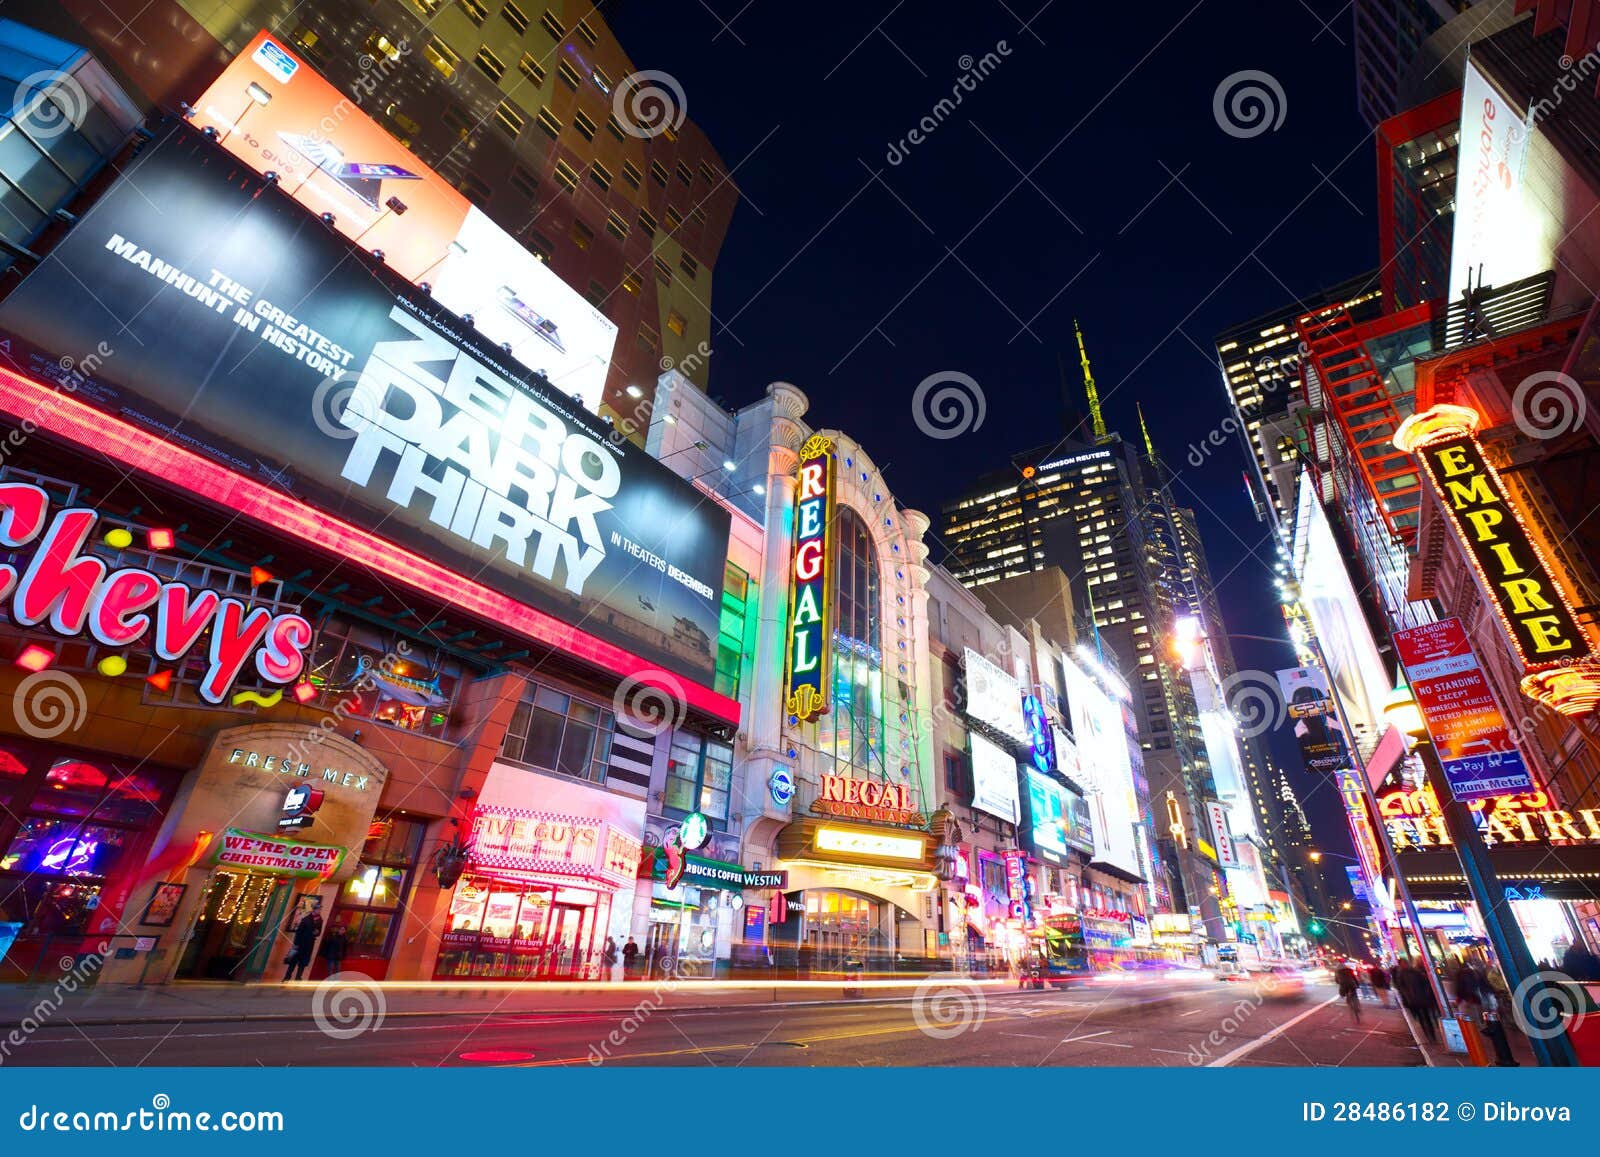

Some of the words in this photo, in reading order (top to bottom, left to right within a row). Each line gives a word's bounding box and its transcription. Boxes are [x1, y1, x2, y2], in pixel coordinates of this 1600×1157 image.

[261, 149, 294, 174] give
[105, 233, 234, 315] MANHUNT
[232, 309, 261, 333] IN
[261, 325, 347, 382] HISTORY
[208, 268, 253, 305] THE
[254, 299, 355, 367] GREATEST
[397, 295, 418, 311] FROM
[417, 308, 431, 321] THE
[430, 317, 463, 344] ACADEMY
[541, 393, 566, 417] DIRECTOR
[573, 416, 586, 430] THE
[586, 426, 603, 442] HURT
[602, 437, 626, 457] LOCKER
[373, 304, 621, 499] ZERO
[346, 354, 614, 555] DARK
[1038, 457, 1075, 472] THOMSON
[1076, 451, 1111, 463] REUTERS
[339, 408, 606, 596] THIRTY
[1434, 445, 1573, 653] EMPIRE
[610, 531, 622, 546] IN
[622, 536, 667, 573] THEATERS
[667, 564, 714, 600] DECEMBER
[794, 463, 825, 674] REGAL
[1398, 630, 1411, 640] NO
[1414, 621, 1455, 639] STANDING
[1415, 665, 1441, 676] OTHER
[1444, 660, 1469, 670] TIMES
[1418, 685, 1432, 696] NO
[1433, 675, 1481, 693] STANDING
[1437, 690, 1469, 702] EXCEPT
[1424, 701, 1461, 714] COMMERCIAL
[1464, 695, 1493, 707] VEHICLES
[1429, 711, 1463, 724] METERED
[1463, 705, 1496, 717] PARKING
[1463, 717, 1488, 728] LIMIT
[1436, 730, 1466, 742] EXCEPT
[1467, 725, 1502, 738] SUNDAY
[228, 749, 309, 777] FRESH
[323, 767, 369, 791] MEX
[1463, 760, 1484, 772] Pay
[1488, 758, 1500, 768] at
[820, 773, 915, 813] REGAL
[1454, 777, 1527, 794] Muni-Meter
[830, 803, 907, 824] CINEMAS
[472, 816, 525, 839] FIVE
[533, 821, 595, 847] GUYS
[223, 836, 287, 855] WE'RE
[289, 846, 339, 860] OPEN
[219, 852, 304, 870] CHRISTMAS
[305, 862, 332, 873] DAY
[684, 863, 717, 879] RBUCKS
[717, 869, 742, 883] COFFEE
[743, 873, 782, 887] WESTIN
[480, 936, 493, 944] FIVE
[495, 937, 511, 945] GUYS
